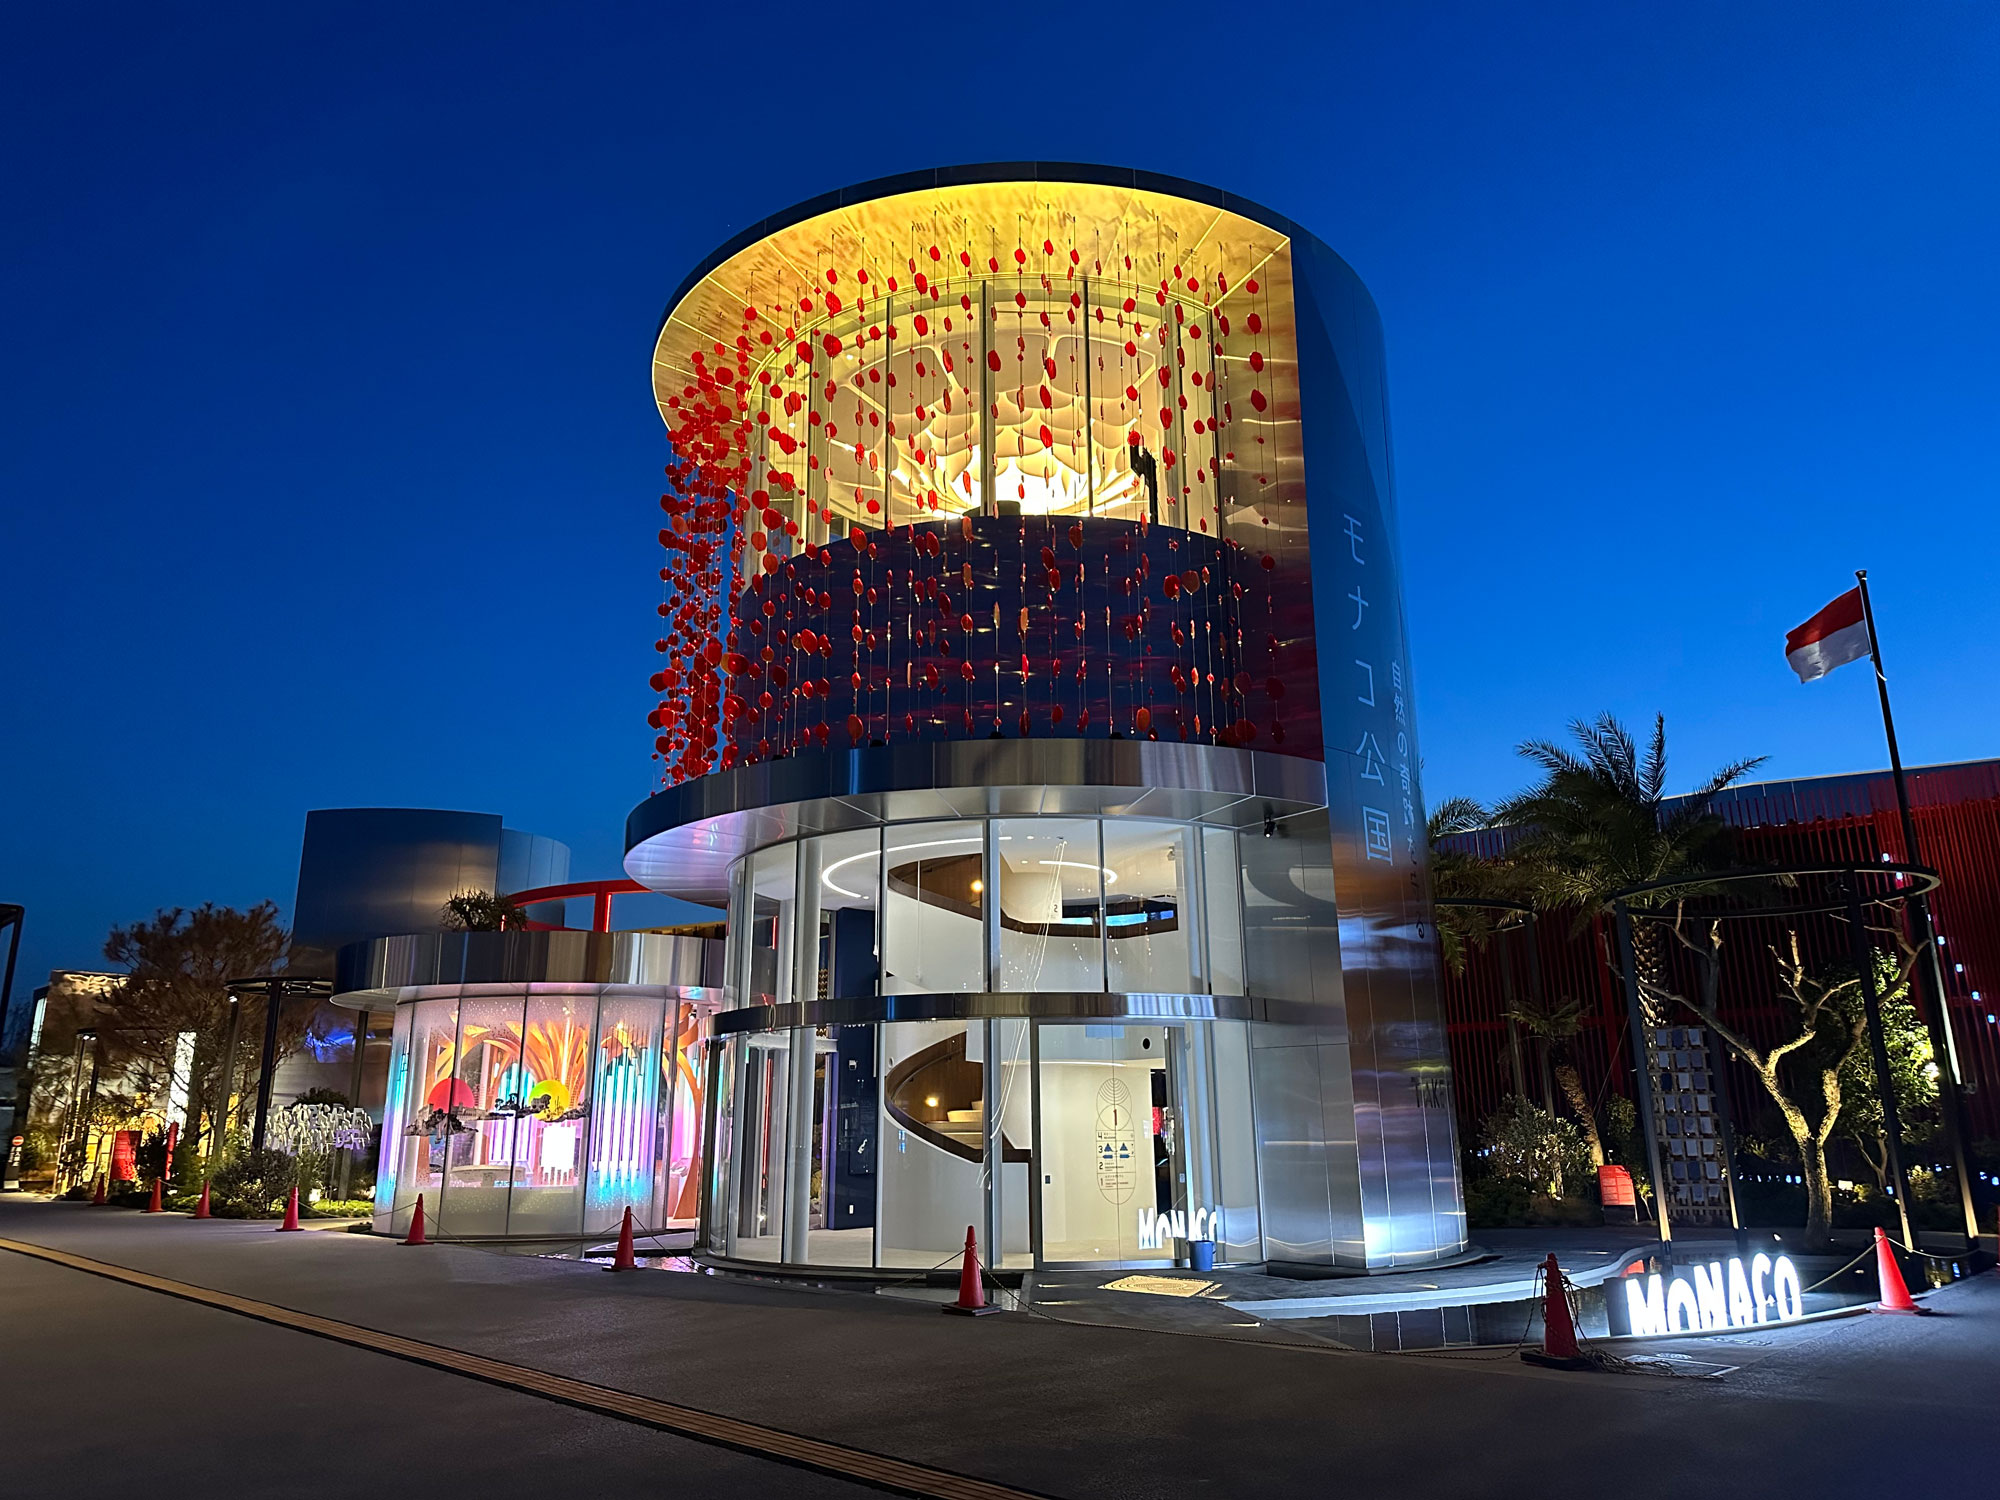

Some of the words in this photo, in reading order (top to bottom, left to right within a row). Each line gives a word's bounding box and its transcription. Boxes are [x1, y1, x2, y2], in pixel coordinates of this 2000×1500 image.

[1343, 512, 1393, 867] モナコ公国
[1097, 1131, 1103, 1140] 4
[1098, 1144, 1104, 1154] 3
[1098, 1161, 1104, 1170] 2
[1625, 1252, 1803, 1336] MONACO
